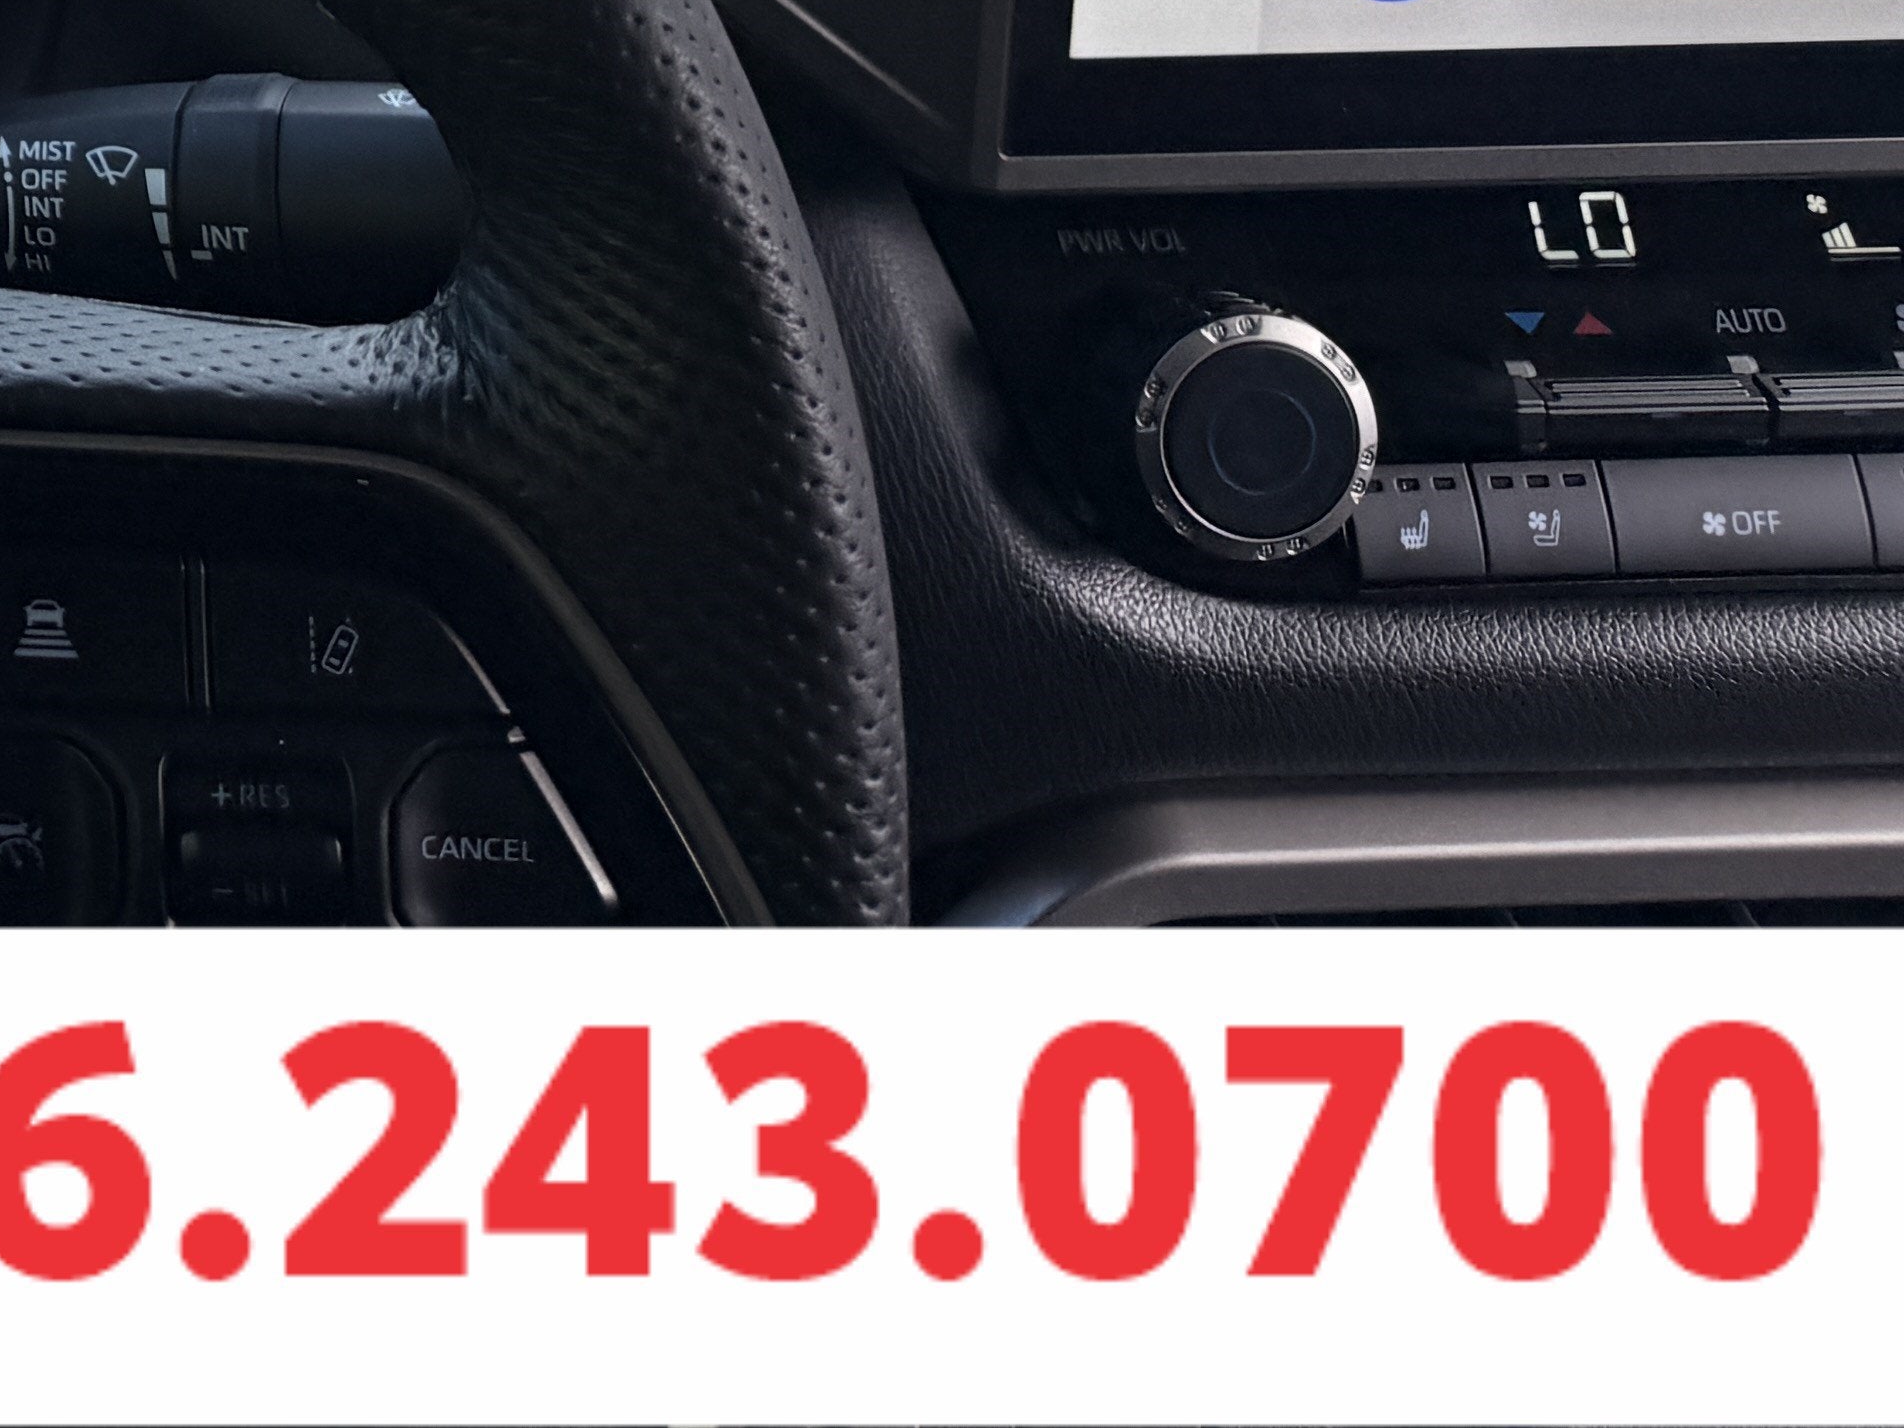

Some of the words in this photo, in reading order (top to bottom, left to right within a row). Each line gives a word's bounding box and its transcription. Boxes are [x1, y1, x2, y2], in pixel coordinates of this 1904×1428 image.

[18, 140, 75, 163] MIST
[21, 168, 68, 191] OFF
[23, 196, 65, 219] INT
[23, 227, 57, 248] LO
[201, 224, 249, 253] INT
[1056, 226, 1122, 256] PWR
[1127, 226, 1187, 255] VOL
[1715, 307, 1787, 336] AUTO
[1731, 510, 1782, 535] OFF
[421, 834, 536, 864] CANCEL
